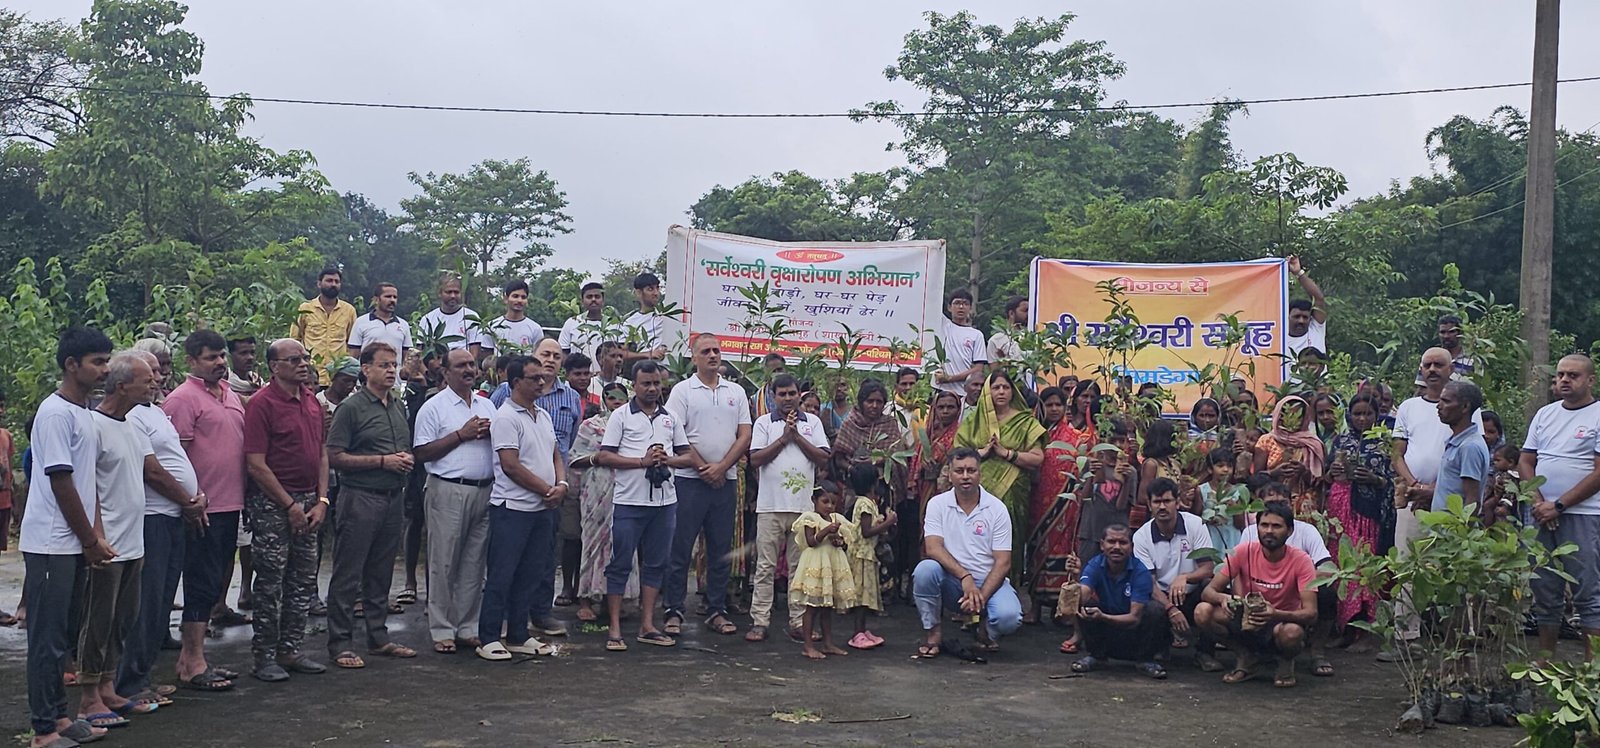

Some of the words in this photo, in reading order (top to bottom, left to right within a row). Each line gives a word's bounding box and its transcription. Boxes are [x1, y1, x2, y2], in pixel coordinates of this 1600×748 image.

[770, 264, 843, 288] वृक्षारोपण
[1189, 277, 1209, 293] से
[722, 285, 737, 293] घर
[866, 290, 887, 305] पेड़
